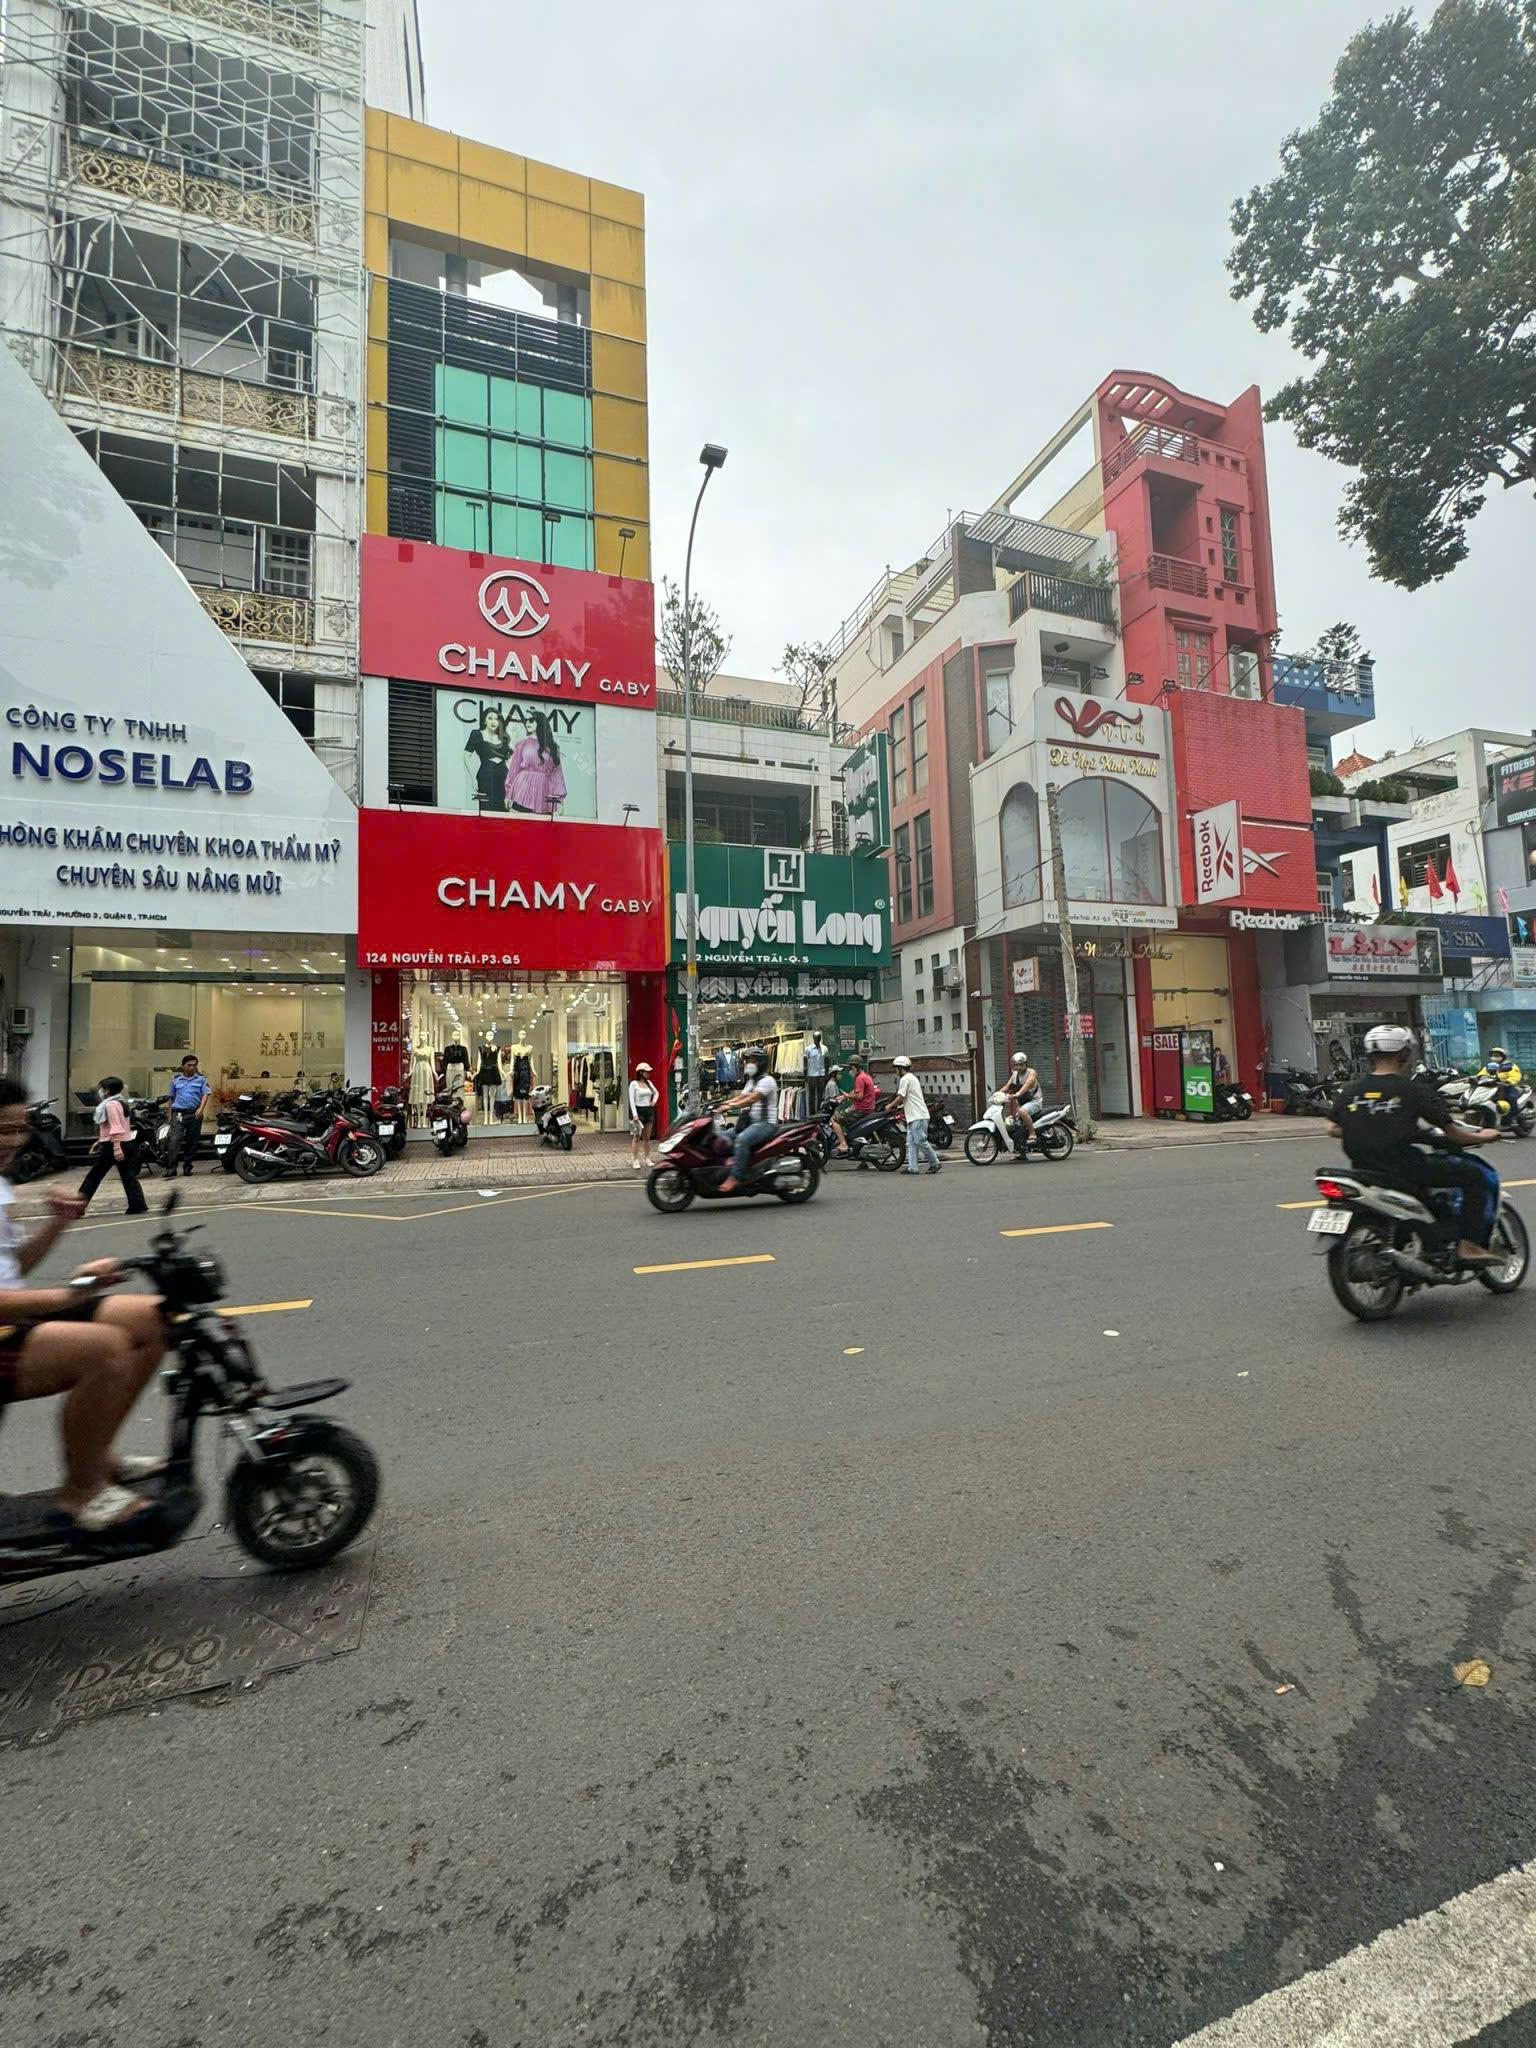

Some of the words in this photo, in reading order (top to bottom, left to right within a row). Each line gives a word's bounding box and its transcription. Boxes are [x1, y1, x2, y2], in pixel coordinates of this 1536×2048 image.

[438, 643, 591, 688] CHAMY
[599, 679, 651, 697] GABY
[6, 704, 77, 731] CÔNG
[84, 714, 113, 735] TY
[123, 719, 188, 742] TNHH
[12, 742, 254, 795] NOSELAB
[126, 830, 200, 855] CHUYÊN
[205, 837, 258, 858] KHOA
[315, 838, 342, 862] MỸ
[1200, 820, 1213, 894] Reebok
[56, 863, 136, 889] CHUYÊN
[142, 865, 179, 890] SÂU
[187, 867, 240, 892] NÂNG
[246, 871, 282, 894] MŨI
[437, 877, 598, 911] CHAMY
[600, 899, 653, 914] GABY
[802, 900, 882, 953] Long
[1230, 910, 1300, 931] Reebok
[365, 952, 388, 963] 124
[391, 948, 443, 963] NGUYỄN
[681, 953, 702, 961] 12
[372, 1021, 398, 1033] 124
[1155, 1035, 1179, 1049] SALE
[67, 1634, 222, 1693] D400
